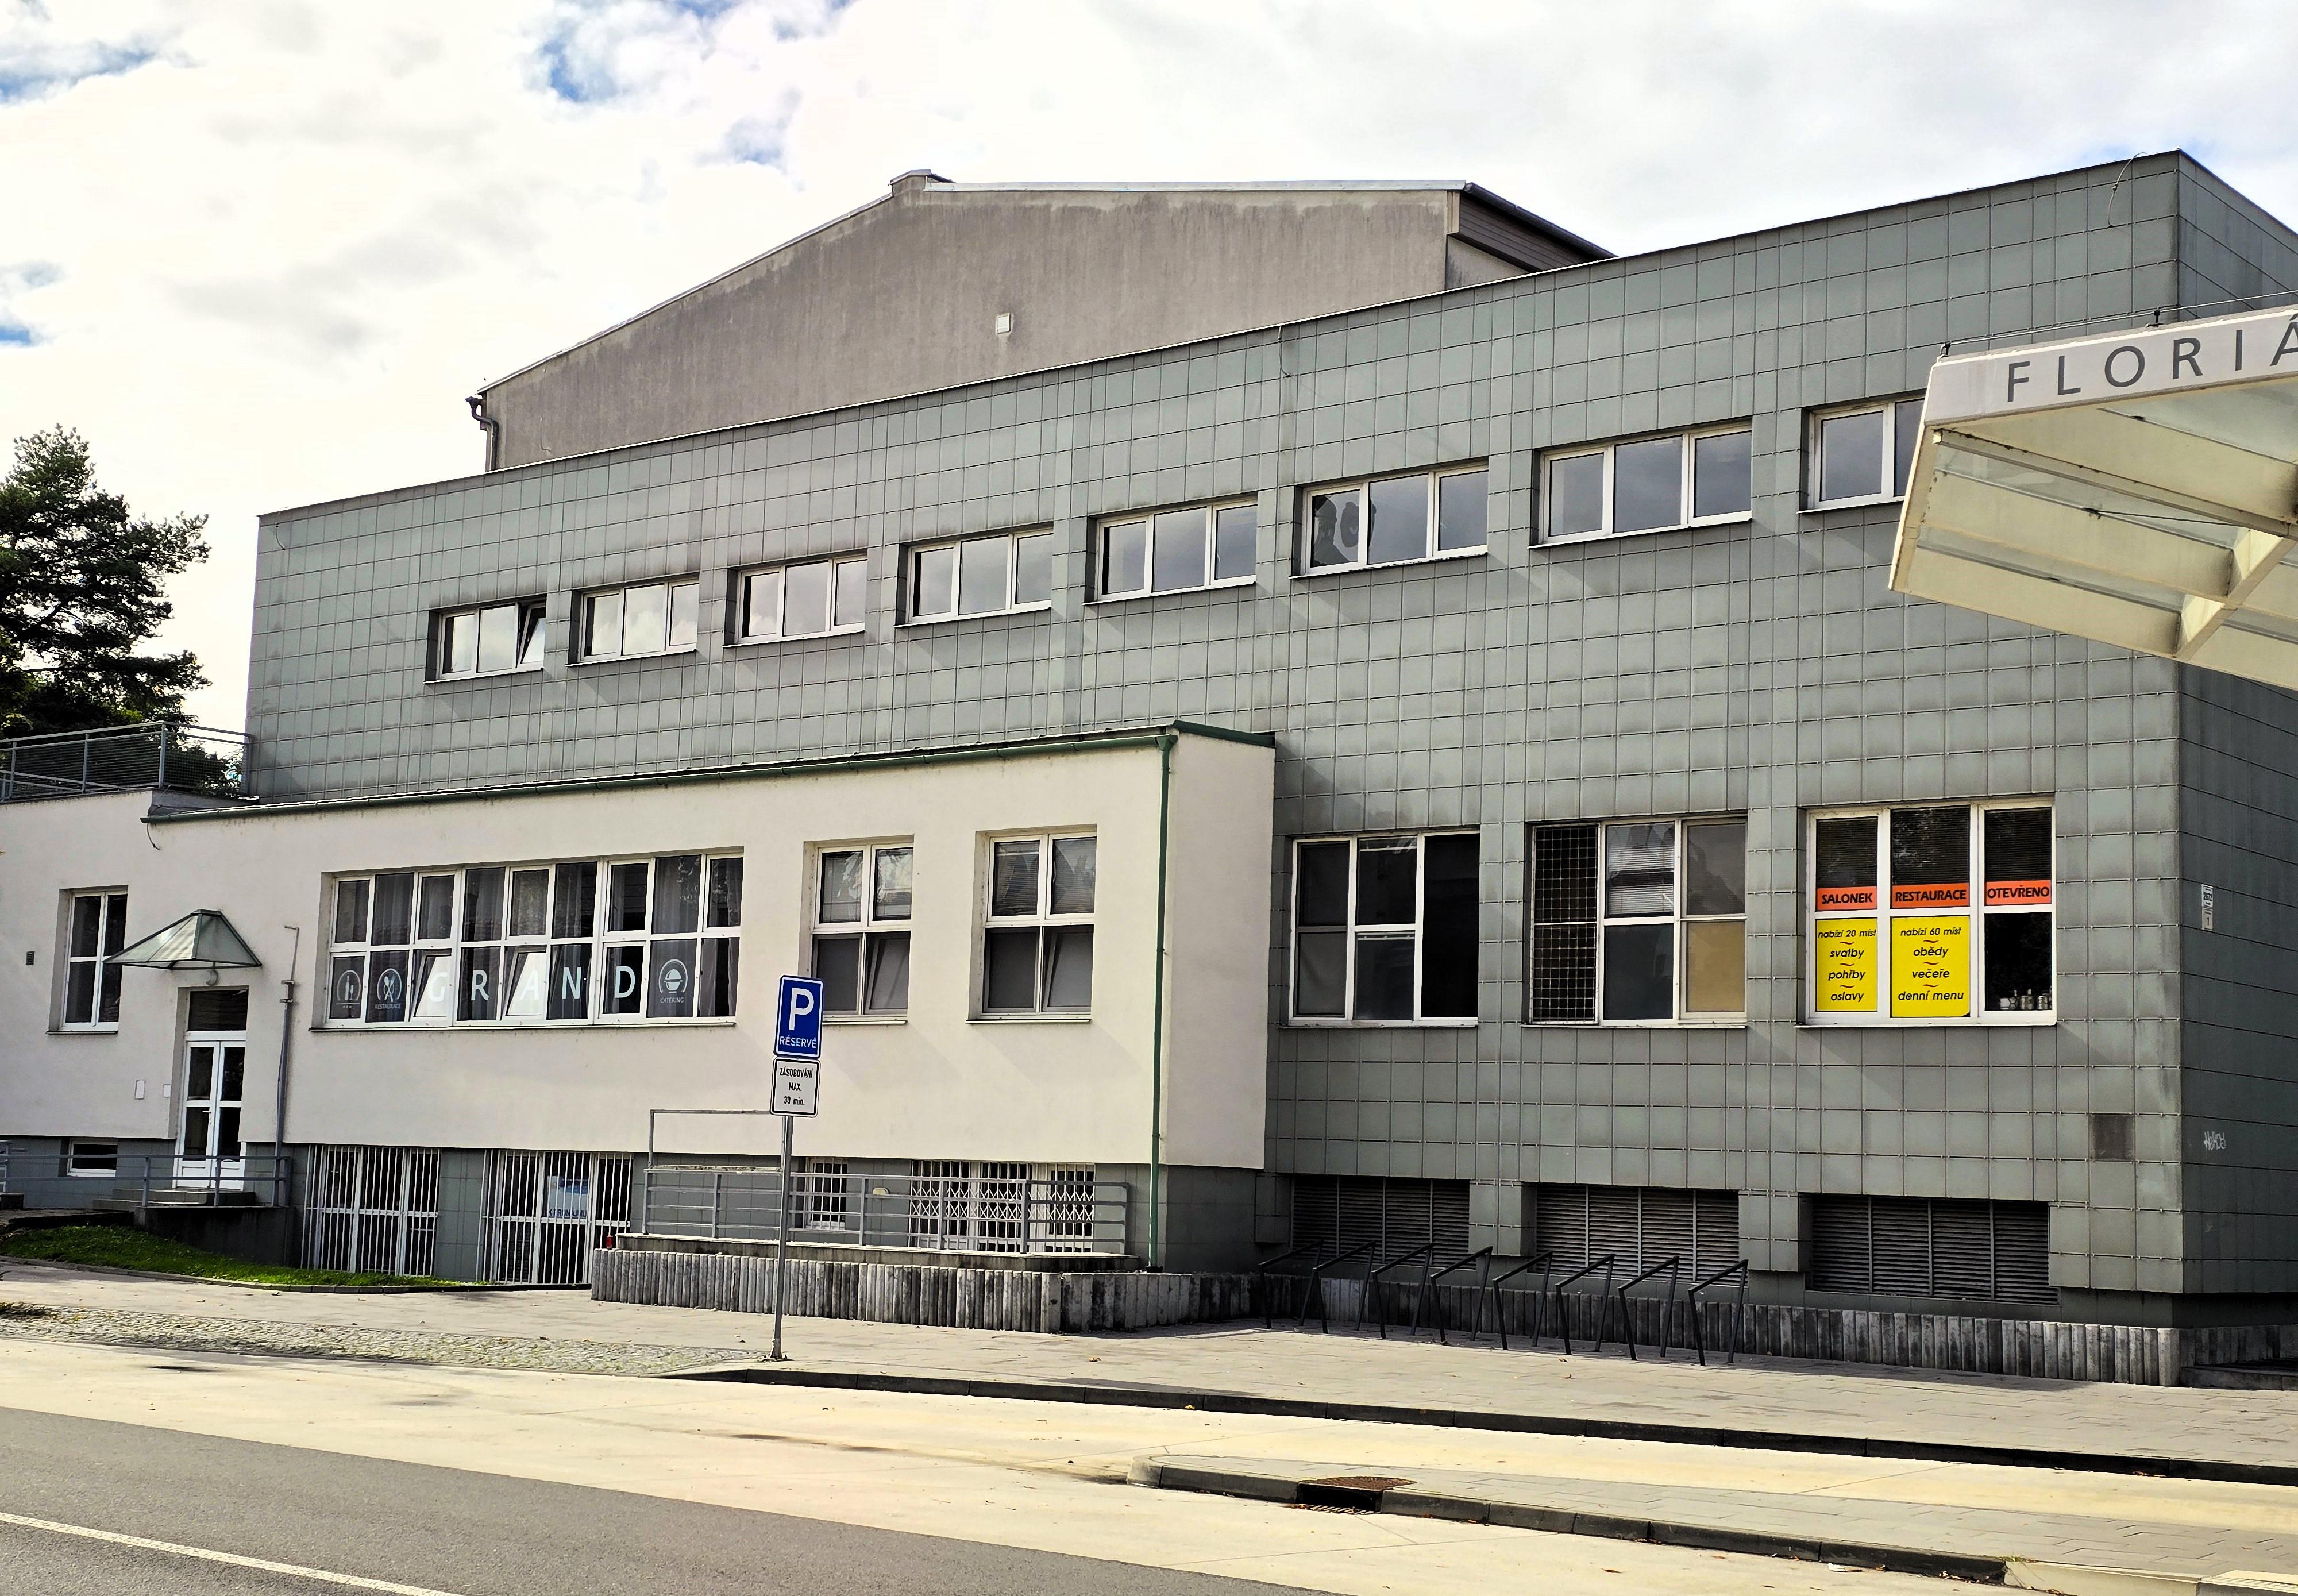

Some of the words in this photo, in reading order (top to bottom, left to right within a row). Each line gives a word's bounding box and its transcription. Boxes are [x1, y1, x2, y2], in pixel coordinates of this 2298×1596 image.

[1895, 889, 1967, 902] RESTAURACE
[1987, 885, 2050, 899] OTEVŘENO
[1822, 893, 1872, 904] SALONEK
[1818, 930, 1844, 938] nabízí
[1845, 930, 1856, 938] 20
[1859, 929, 1877, 937] míst
[1900, 928, 1928, 936] nabízí
[1944, 927, 1961, 935] míst
[1830, 948, 1864, 959] svatby
[1913, 946, 1949, 958] obědy
[1828, 969, 1866, 981] pohřby
[1912, 969, 1950, 978] večeře
[1830, 991, 1864, 1002] oslavy
[1898, 990, 1930, 1000] denní
[789, 987, 815, 1031] P
[779, 1035, 817, 1048] RÉSERVÉ
[780, 1066, 813, 1078] ZÁSOBOVÁNÍ
[784, 1096, 791, 1105] 30
[793, 1096, 805, 1105] min.
